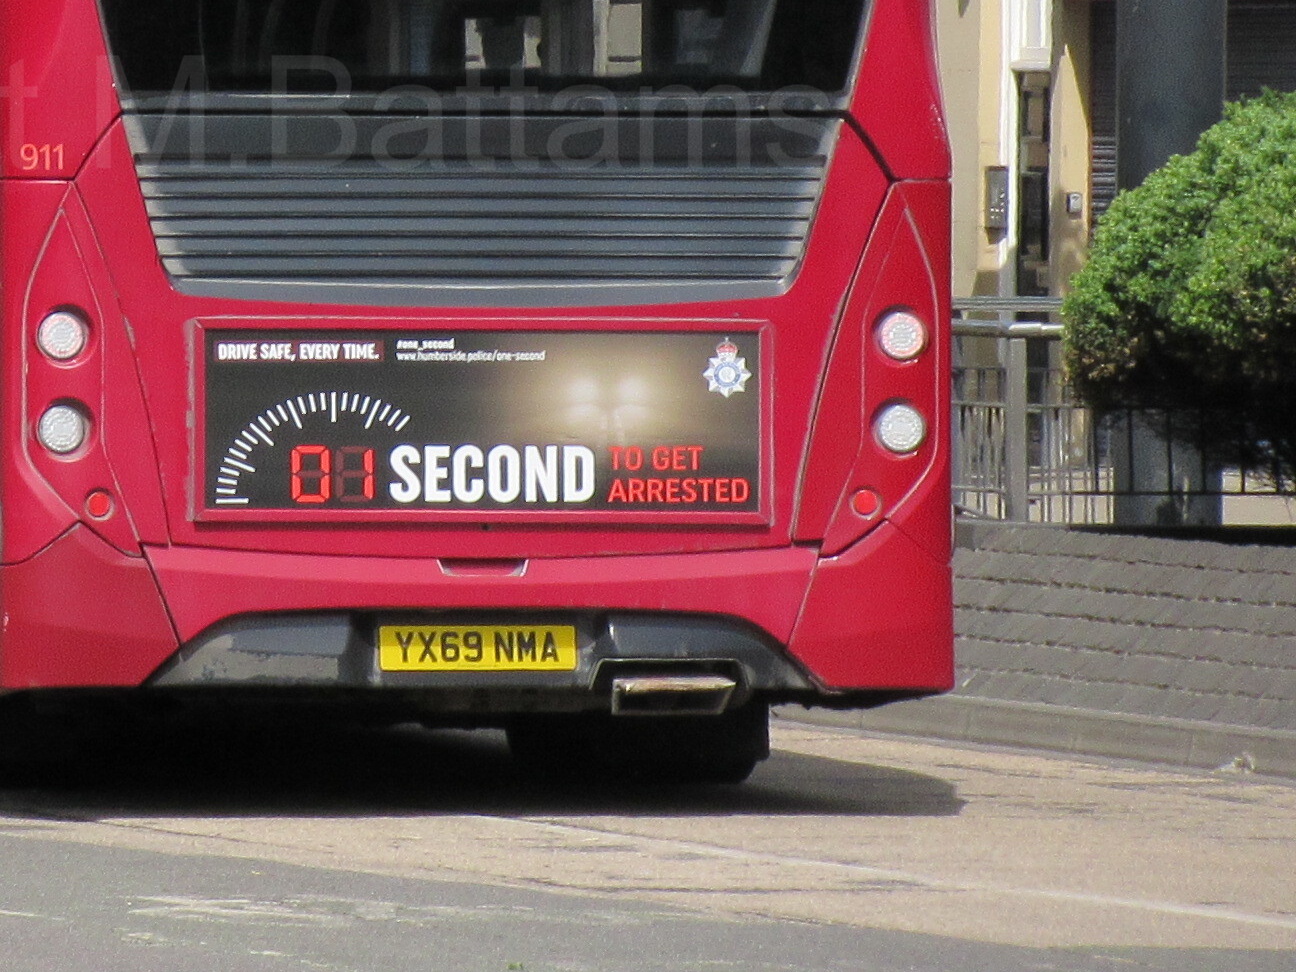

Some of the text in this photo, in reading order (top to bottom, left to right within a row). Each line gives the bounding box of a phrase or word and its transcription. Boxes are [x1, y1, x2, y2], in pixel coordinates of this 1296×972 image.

[20, 143, 64, 171] 911
[217, 342, 381, 362] DRIVE SAFE, EVERY TIME.
[609, 445, 703, 471] TO GET
[389, 444, 597, 505] SECOND
[607, 477, 750, 504] ARRESTED
[395, 631, 560, 664] YX69 NMA
